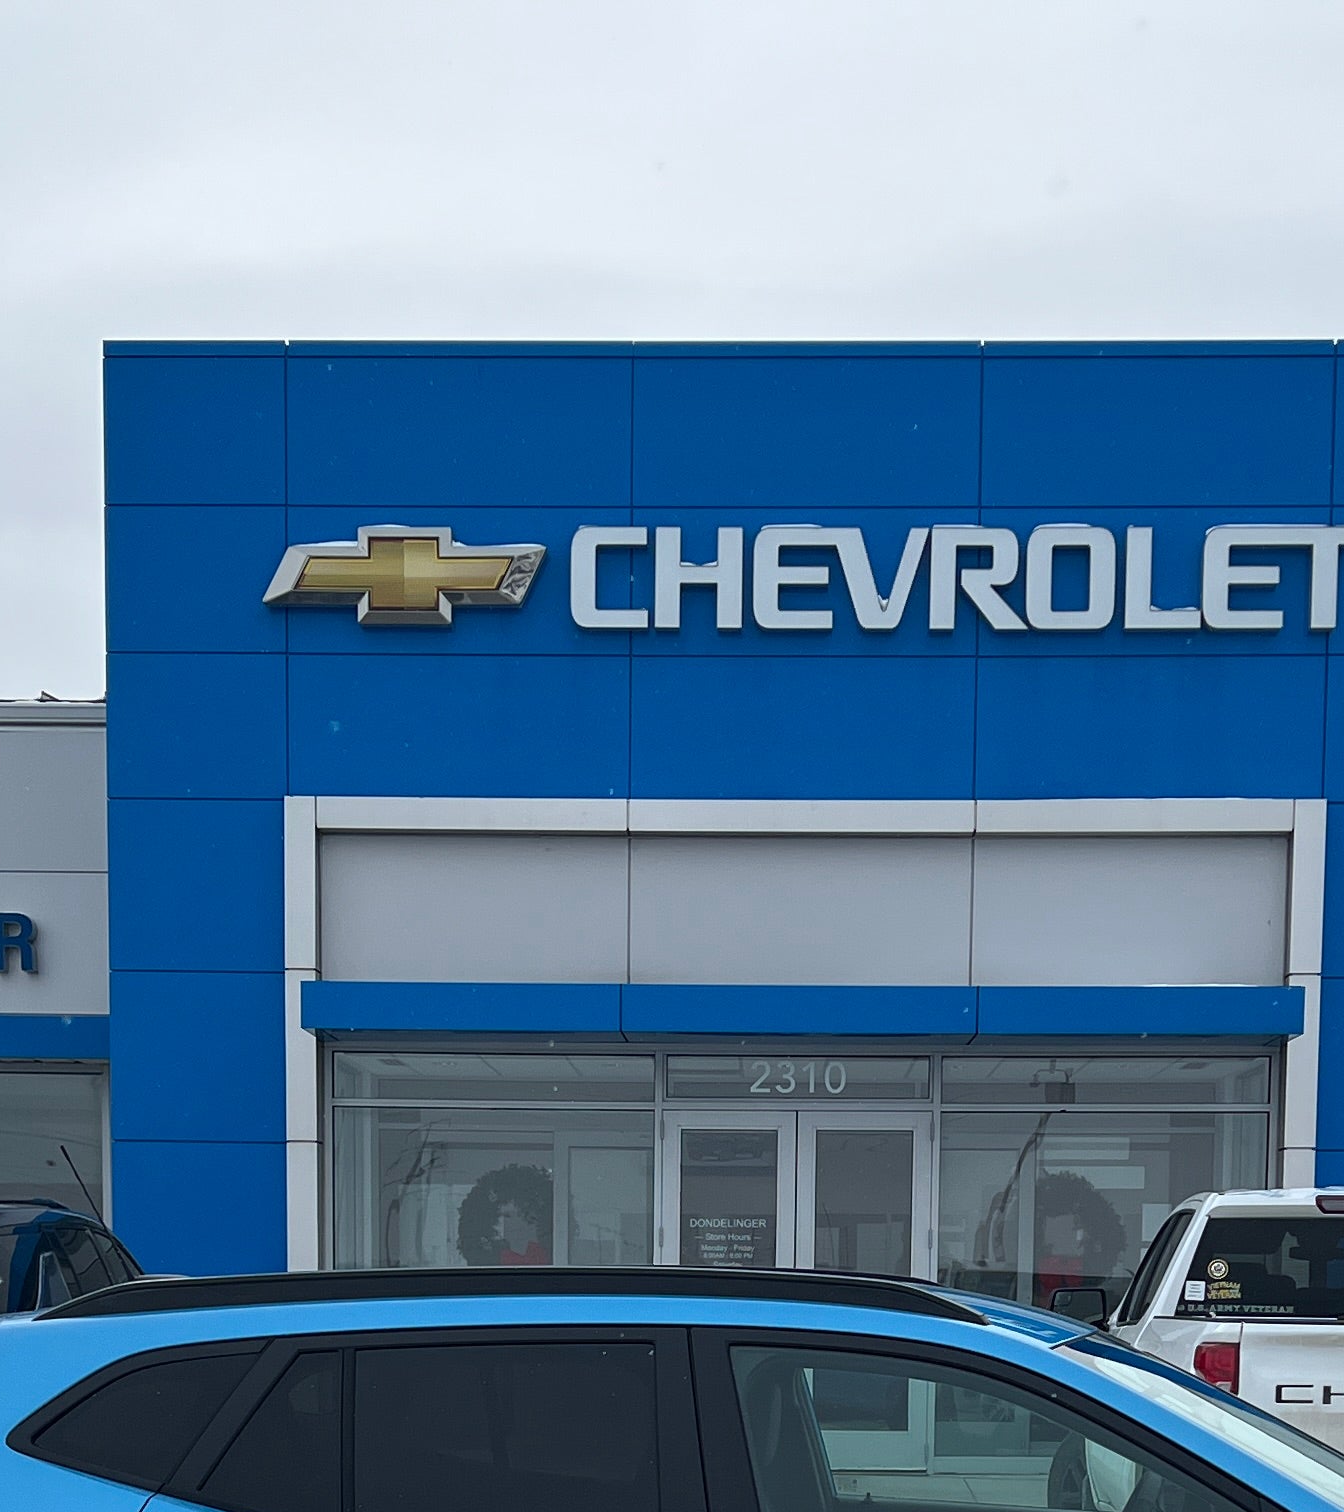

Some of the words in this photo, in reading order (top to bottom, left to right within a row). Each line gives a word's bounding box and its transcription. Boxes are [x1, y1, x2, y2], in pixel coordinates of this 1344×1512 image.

[749, 1060, 847, 1094] 2310
[689, 1218, 767, 1228] DONDELINGER
[705, 1232, 726, 1241] Store
[727, 1233, 752, 1241] Hours
[1207, 1289, 1242, 1299] VETERAN
[1187, 1304, 1206, 1312] U.S.
[1208, 1304, 1240, 1313] ARMY
[1242, 1304, 1294, 1314] VETERAN
